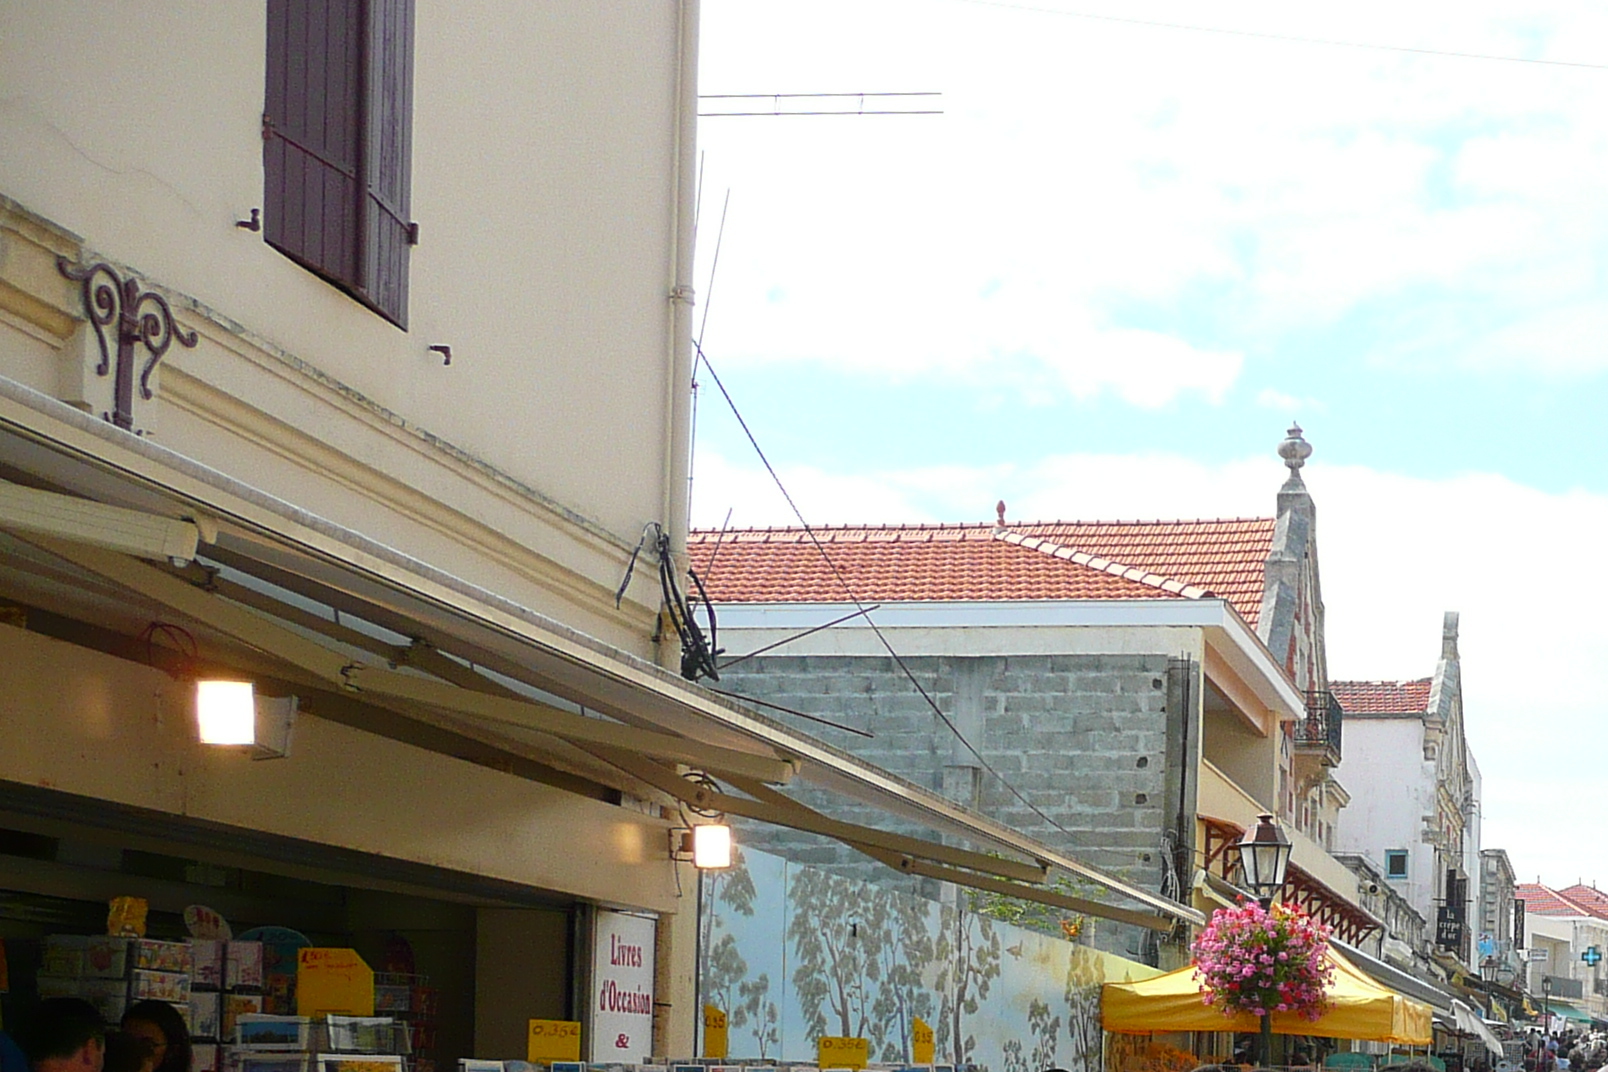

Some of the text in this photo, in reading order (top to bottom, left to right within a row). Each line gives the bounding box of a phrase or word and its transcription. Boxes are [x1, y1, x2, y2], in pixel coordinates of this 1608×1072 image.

[610, 933, 642, 968] Livres
[600, 980, 650, 1015] d'Occasion
[615, 1033, 629, 1049] &
